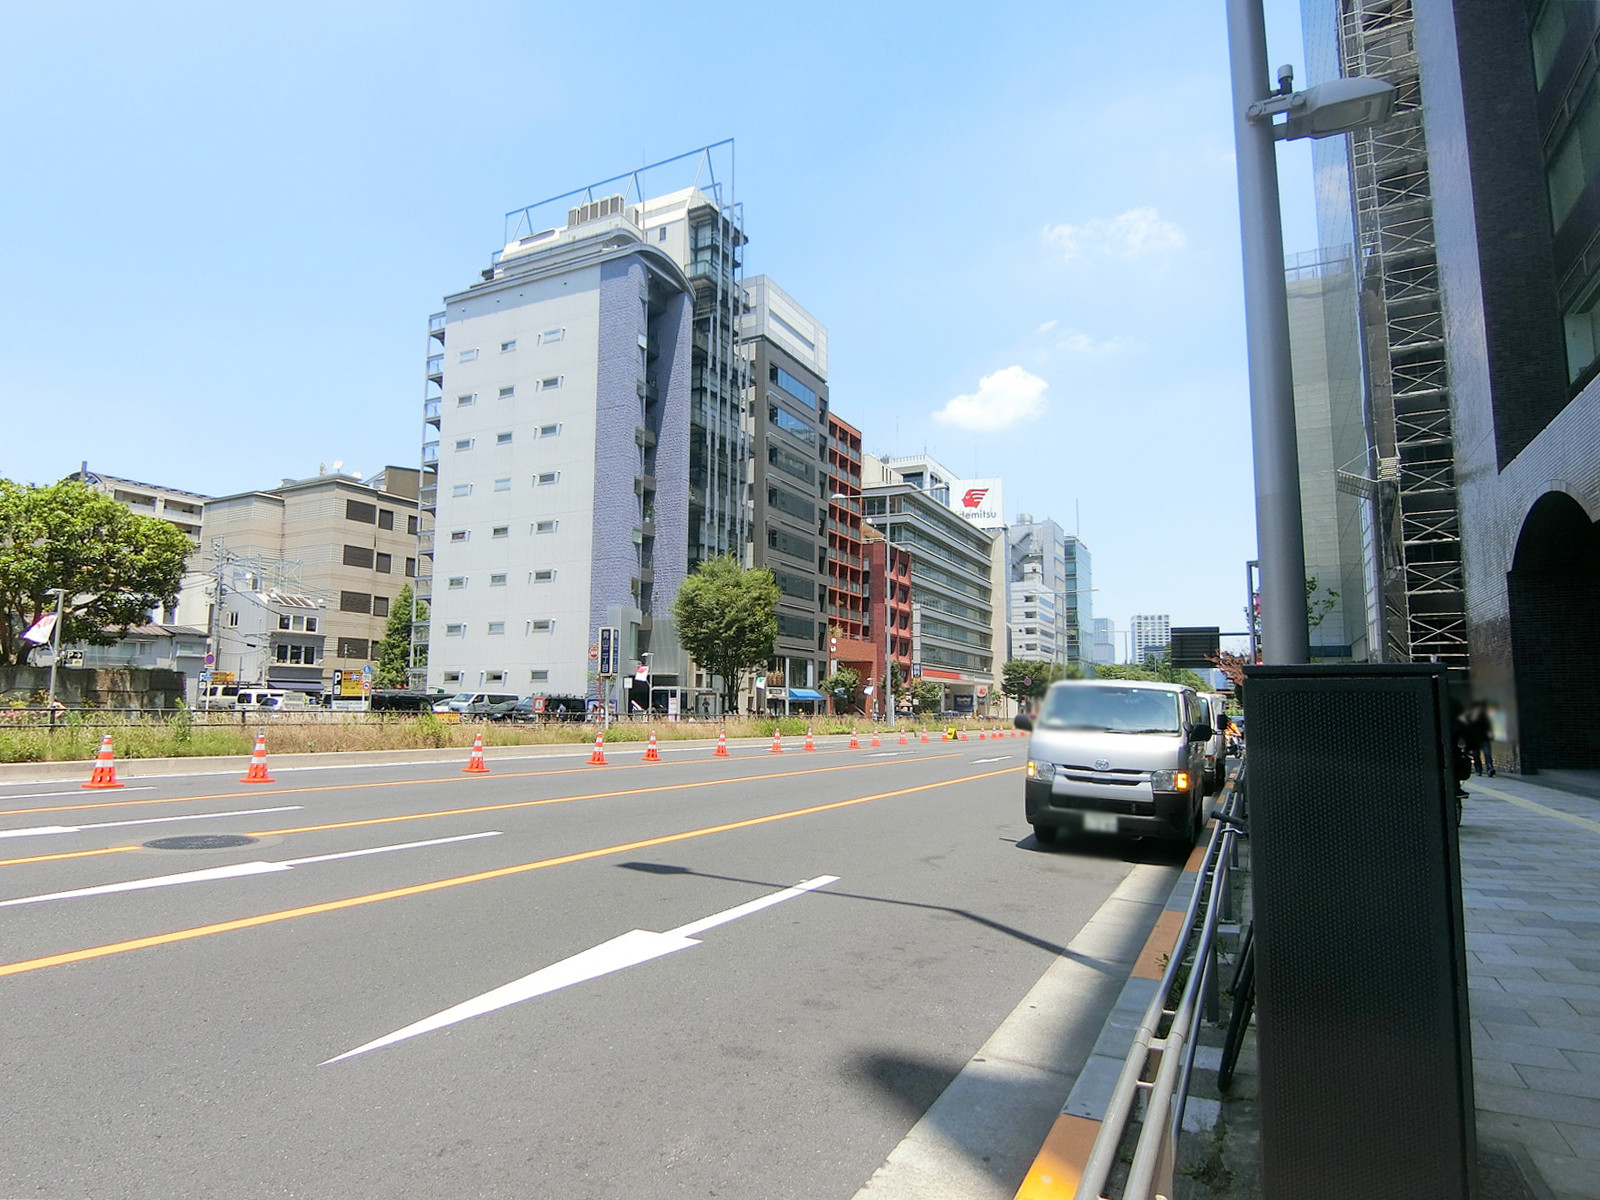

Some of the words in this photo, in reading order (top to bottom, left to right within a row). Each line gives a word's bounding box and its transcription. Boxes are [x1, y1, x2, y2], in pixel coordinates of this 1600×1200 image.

[956, 509, 997, 519] demitsu
[67, 651, 74, 659] P
[334, 672, 342, 684] P
